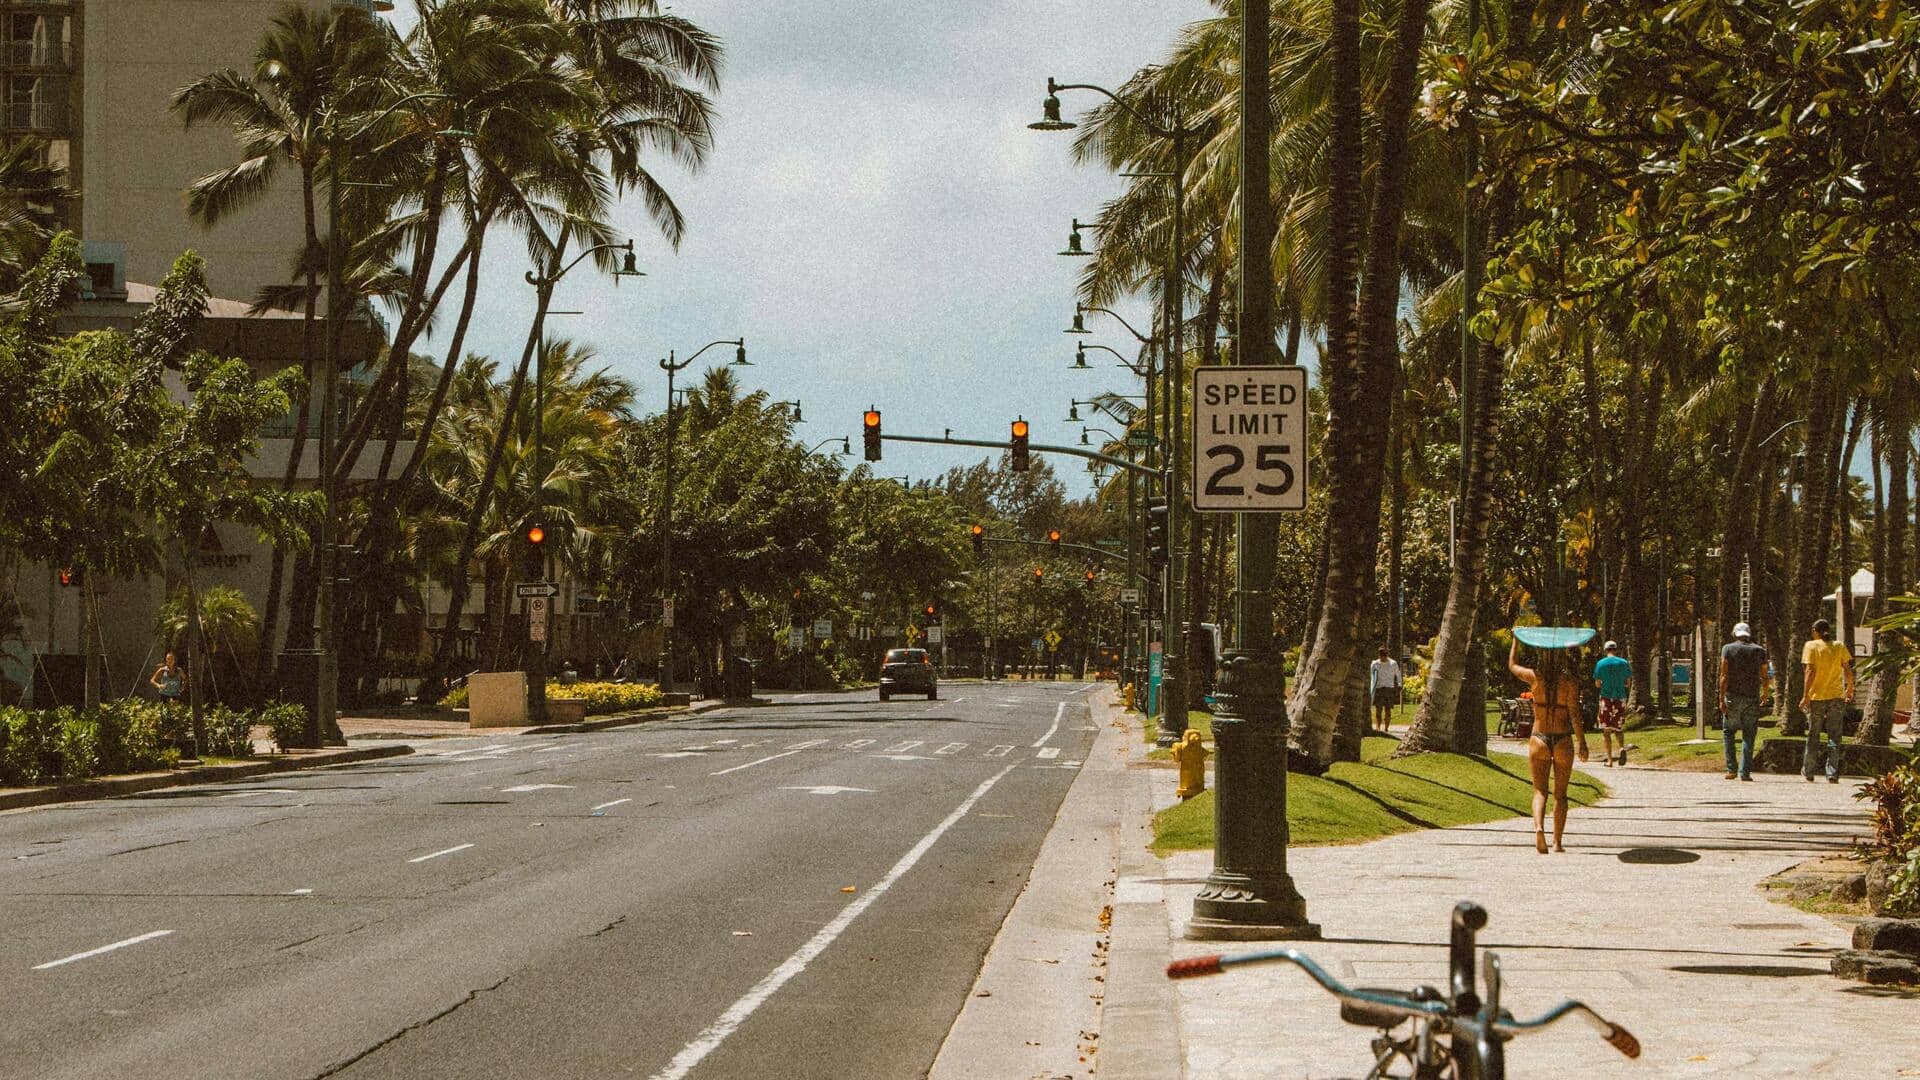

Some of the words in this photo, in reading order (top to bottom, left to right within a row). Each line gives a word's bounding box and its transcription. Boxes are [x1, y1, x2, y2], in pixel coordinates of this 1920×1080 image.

[1205, 385, 1297, 405] SPEED
[1212, 414, 1288, 435] LIMIT
[1205, 445, 1295, 496] 25
